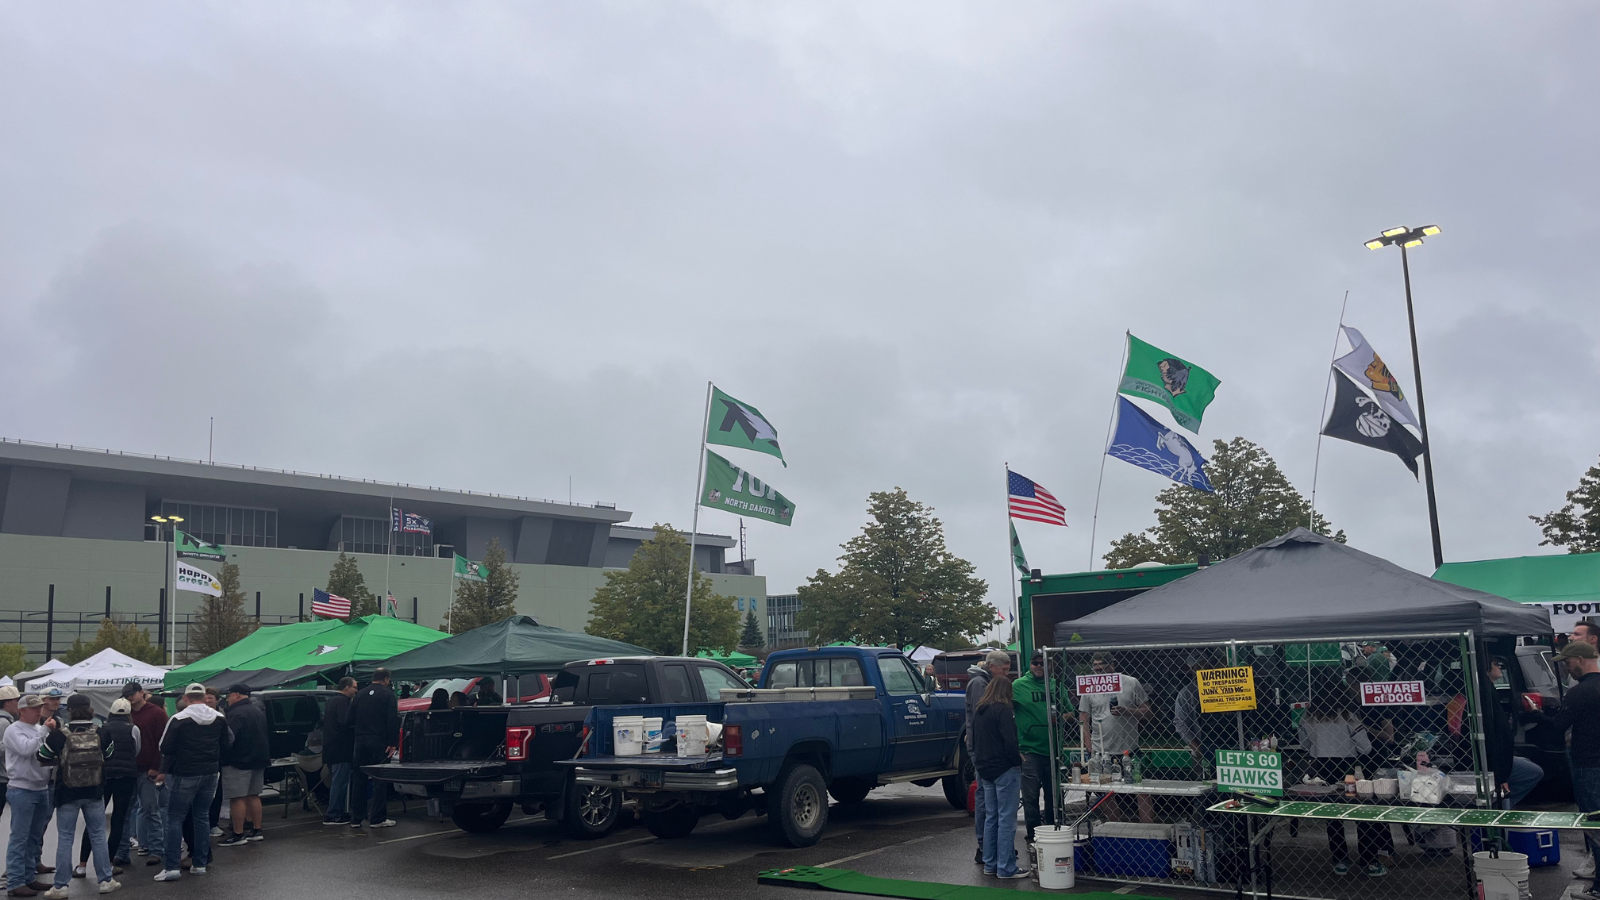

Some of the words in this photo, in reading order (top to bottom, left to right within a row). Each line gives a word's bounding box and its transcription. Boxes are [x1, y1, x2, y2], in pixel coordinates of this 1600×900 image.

[724, 497, 748, 510] NORTH
[748, 503, 776, 516] DAKOTA
[179, 567, 213, 583] Happy
[1200, 668, 1249, 681] WARNING!
[86, 677, 141, 686] FIGHTING
[1079, 675, 1118, 686] BEWARE
[1211, 678, 1247, 686] TRESPASSING
[1085, 685, 1093, 693] of
[1095, 683, 1113, 693] DOG
[1364, 683, 1420, 694] BEWARE
[1374, 693, 1384, 703] of
[1388, 693, 1413, 703] DOG
[1219, 751, 1255, 766] LET'S
[1258, 754, 1278, 767] GO
[1220, 768, 1279, 786] HAWKS
